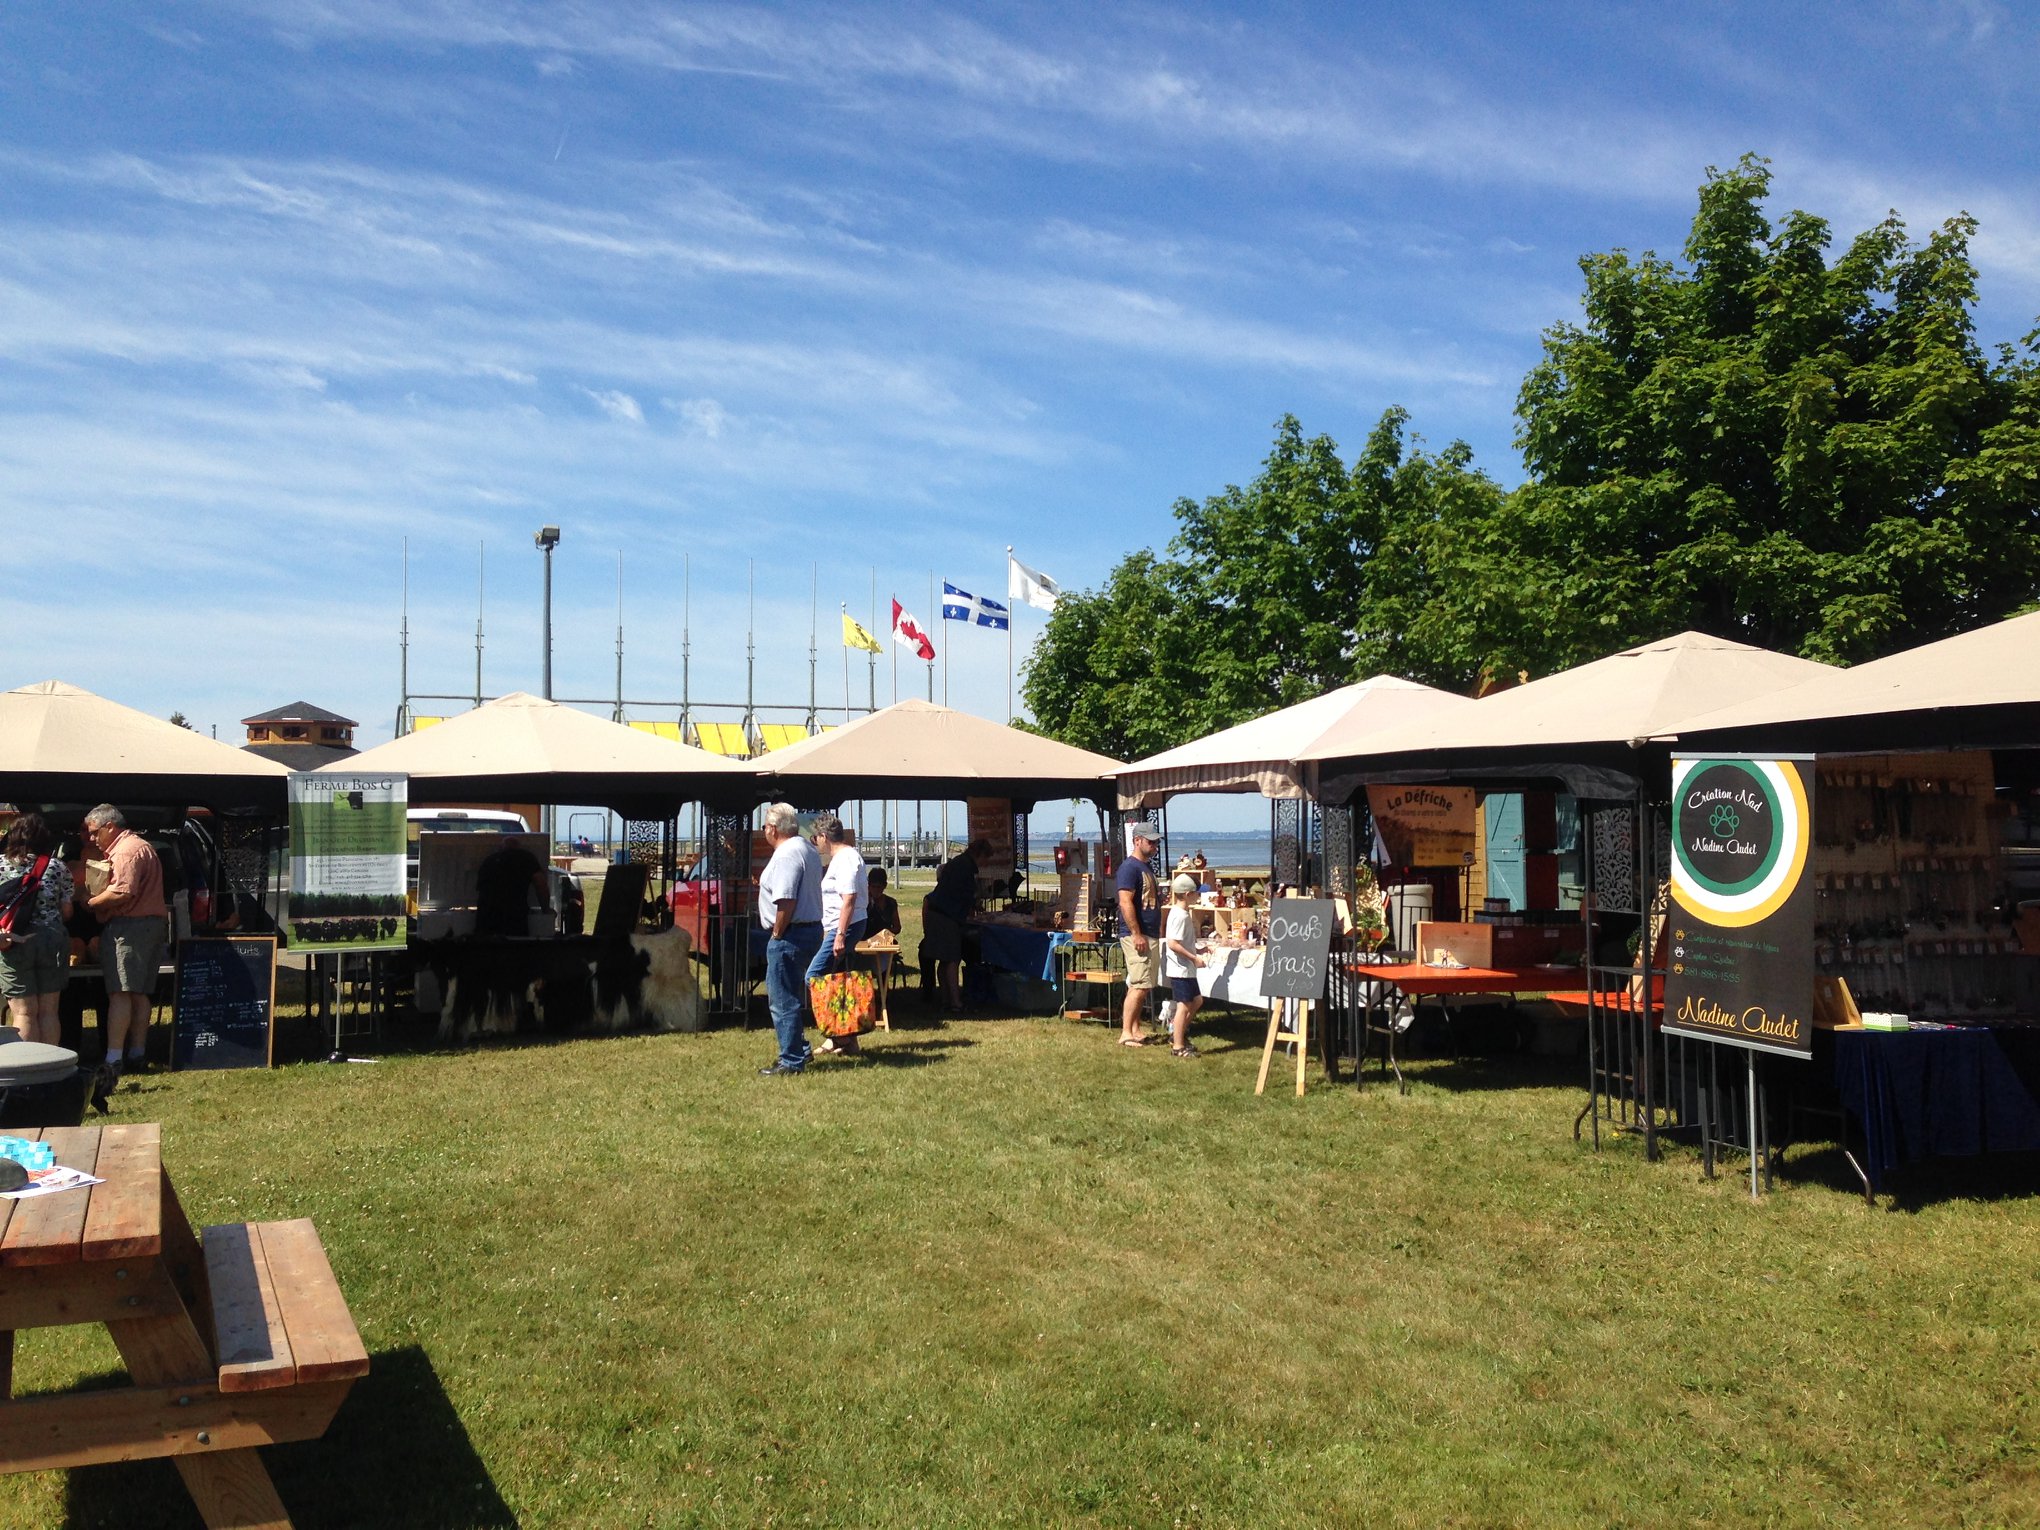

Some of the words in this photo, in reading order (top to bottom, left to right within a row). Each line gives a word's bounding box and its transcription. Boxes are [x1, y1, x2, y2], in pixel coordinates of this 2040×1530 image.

[305, 778, 348, 791] FERME
[352, 778, 377, 791] BOS
[380, 778, 393, 791] G
[1386, 796, 1402, 811] La
[1404, 789, 1454, 811] Défriche
[1734, 789, 1763, 813] Nad
[1691, 837, 1725, 853] Nadine
[1726, 839, 1758, 855] Audet
[1269, 915, 1322, 942] Oeufs
[1267, 945, 1316, 978] frais
[1677, 995, 1738, 1028] Nadine
[1741, 1006, 1800, 1039] Audet
